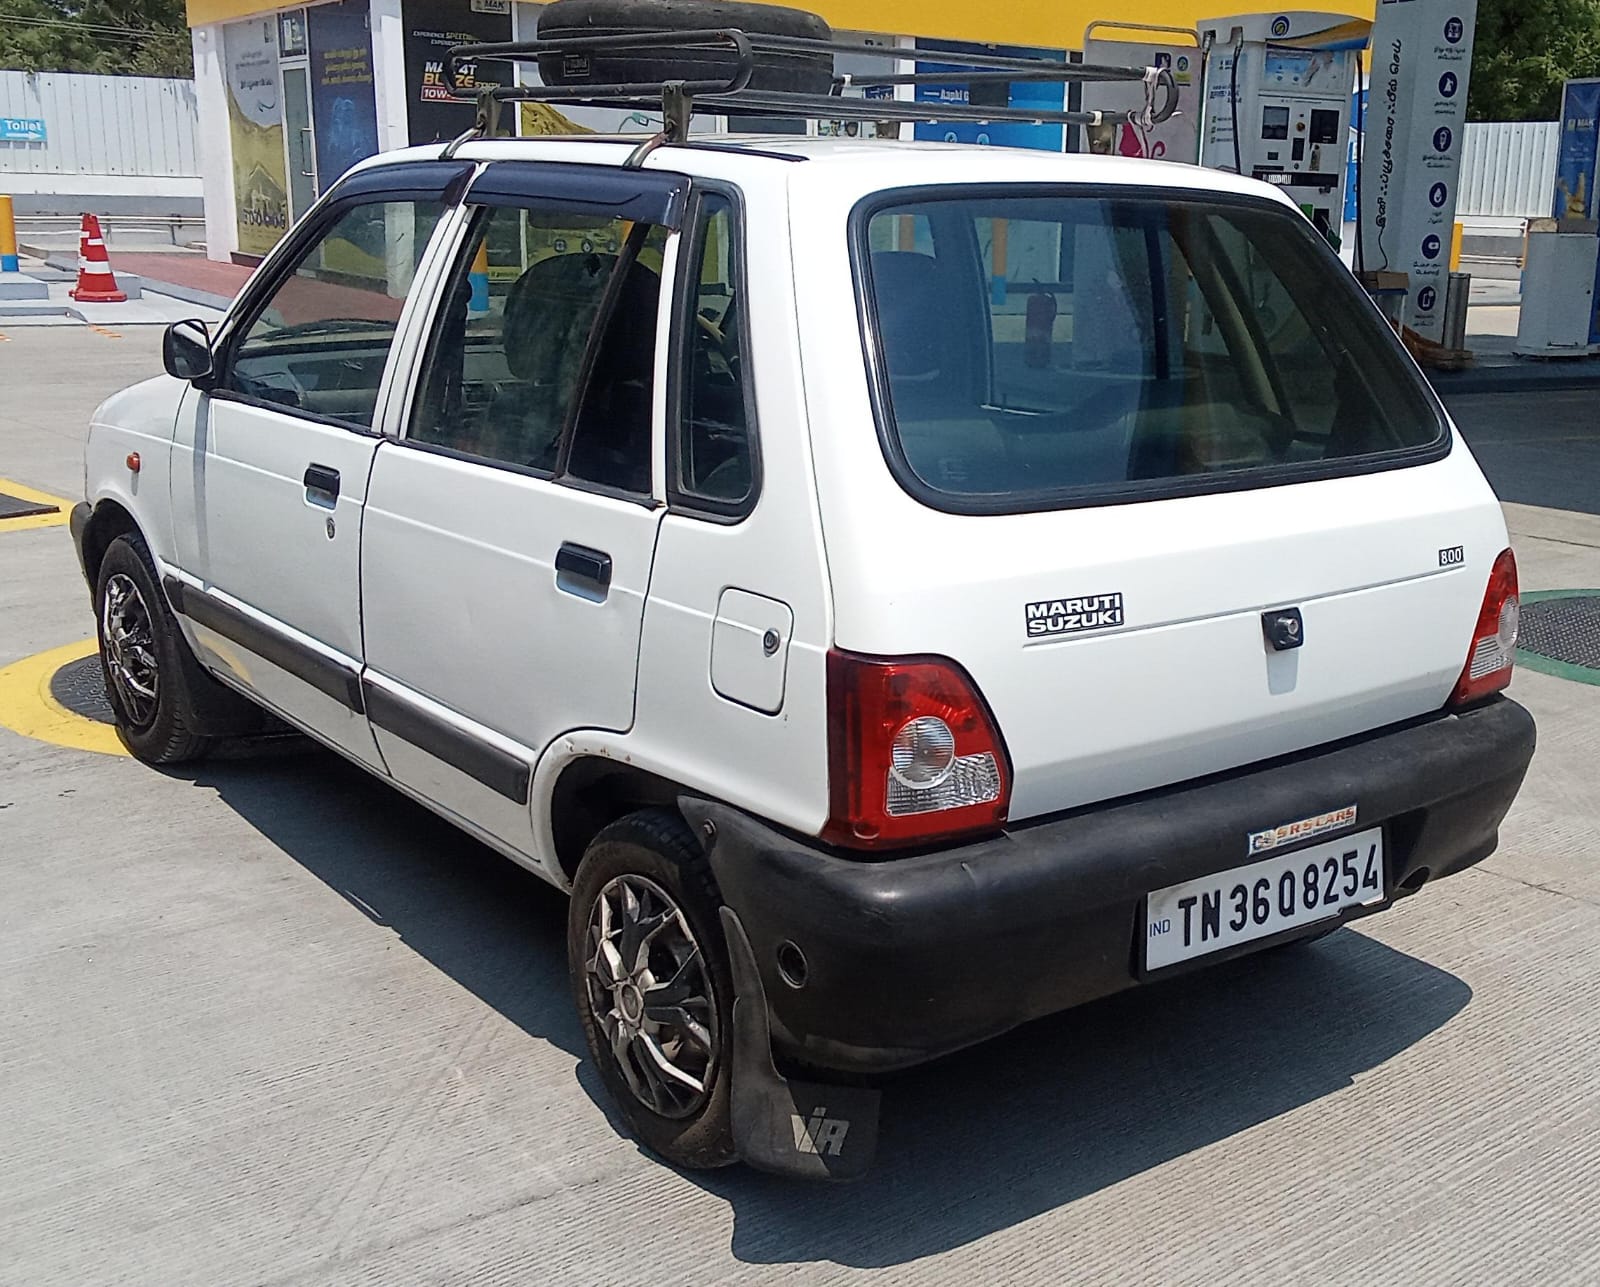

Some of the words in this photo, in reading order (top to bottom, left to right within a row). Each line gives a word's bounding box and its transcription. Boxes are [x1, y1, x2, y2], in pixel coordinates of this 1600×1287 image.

[458, 64, 478, 75] 4T
[423, 72, 475, 88] BLZE
[4, 120, 42, 131] Toilet
[1440, 546, 1464, 566] 800
[1026, 593, 1121, 619] MARUTI
[1028, 609, 1122, 635] SUZUKI
[1149, 918, 1171, 938] IND
